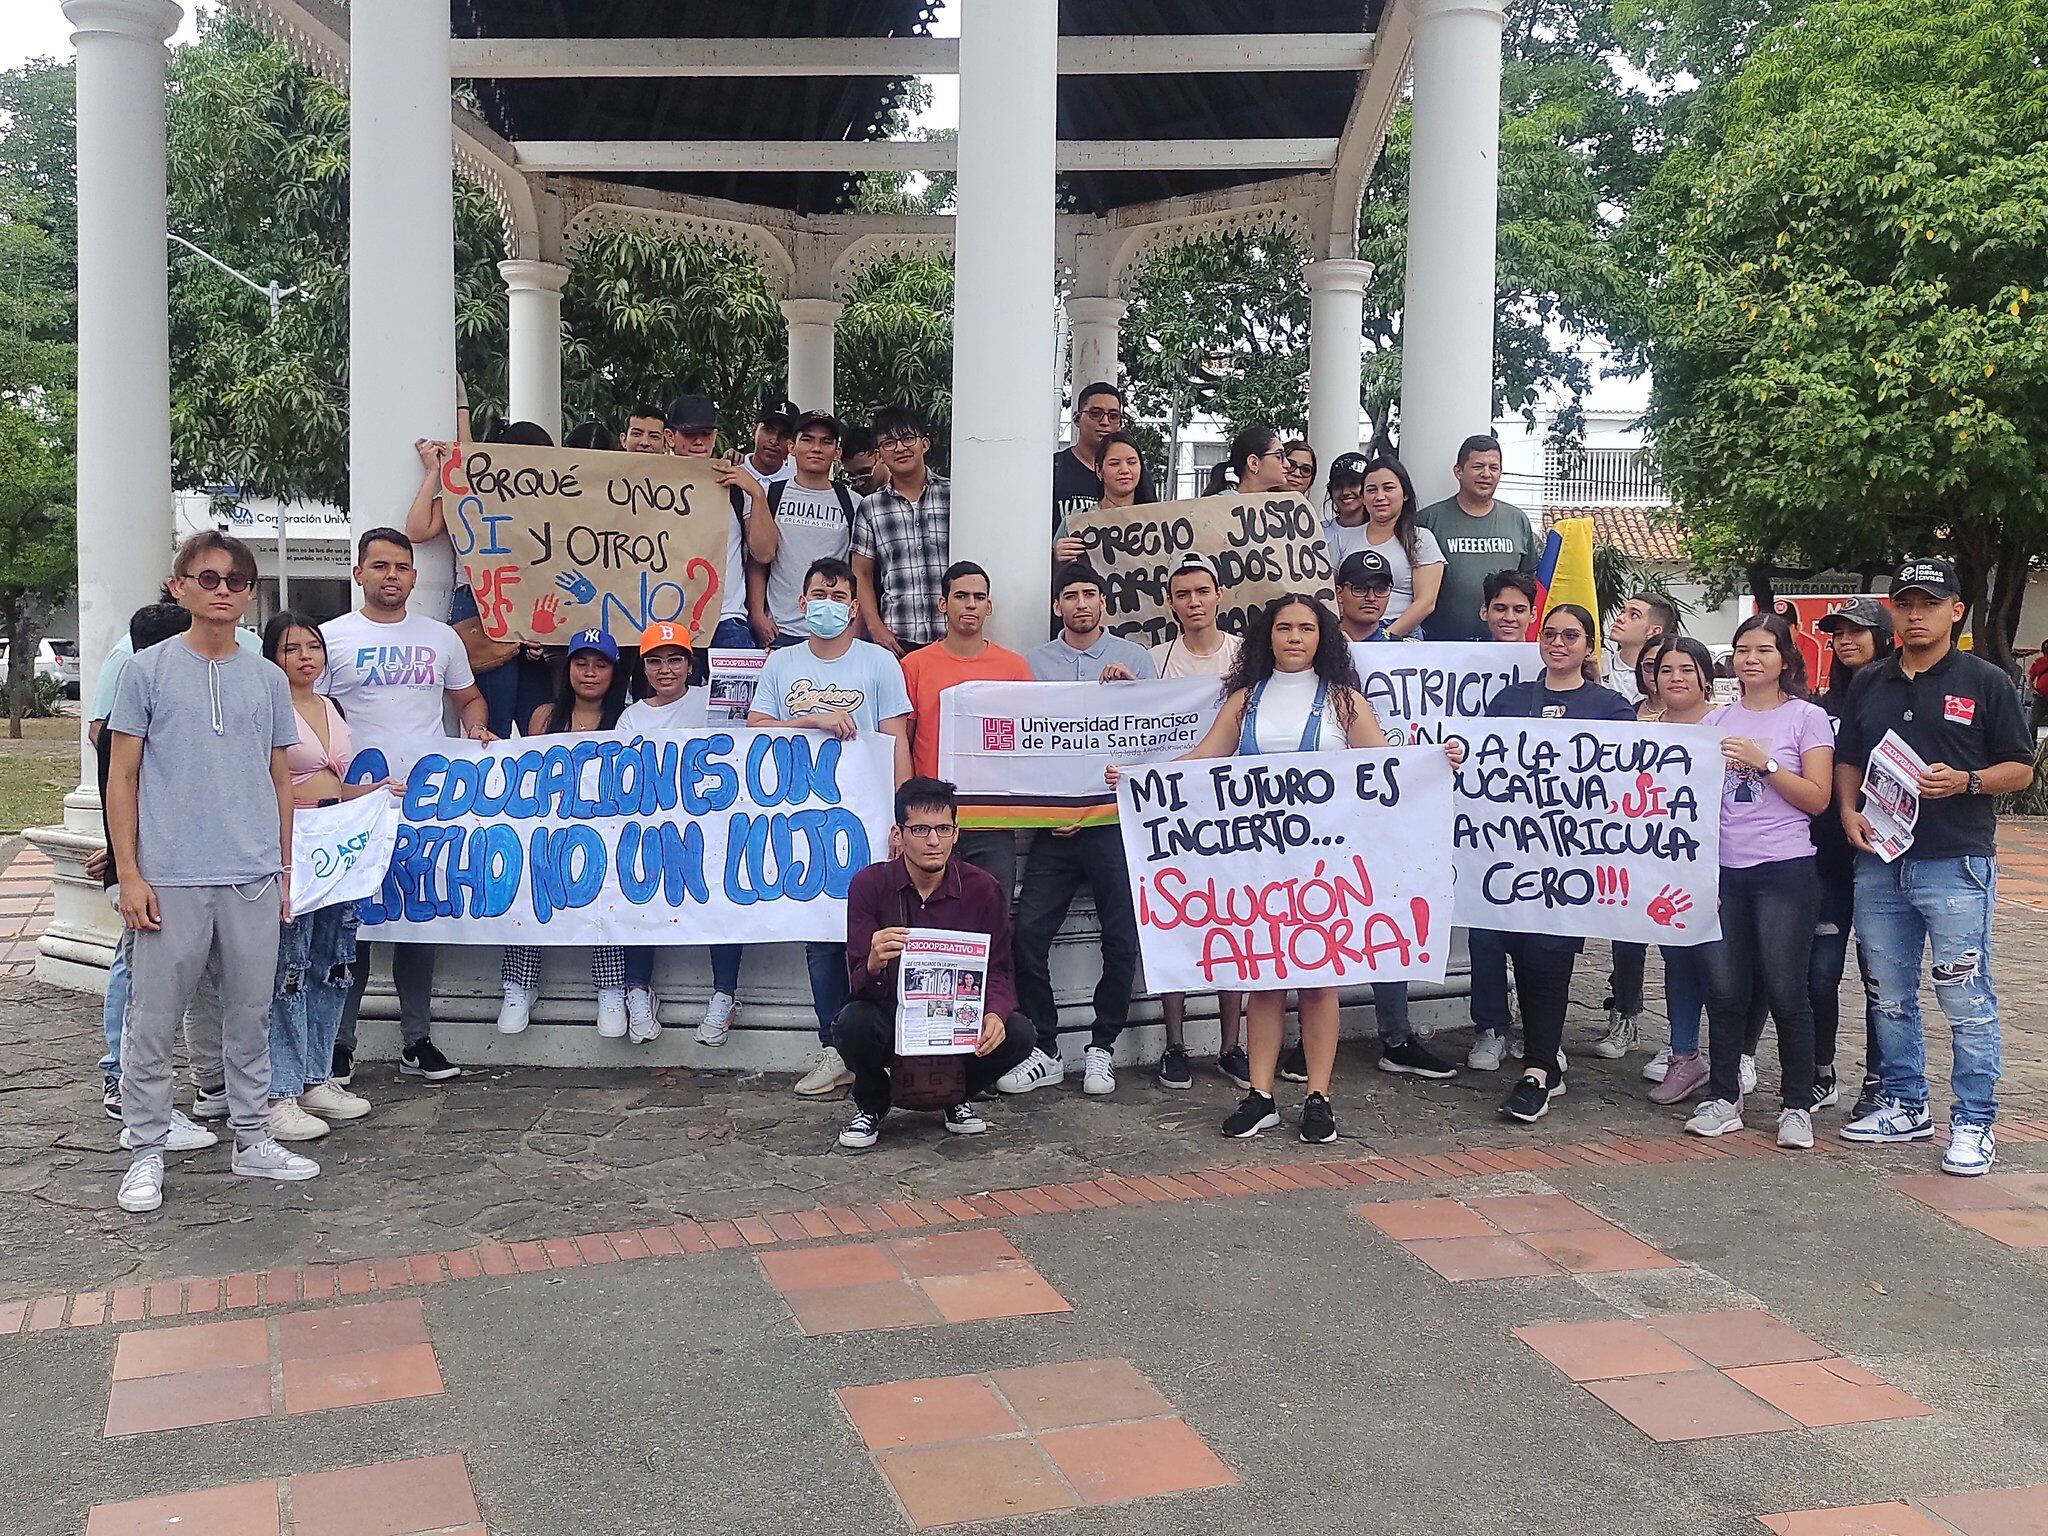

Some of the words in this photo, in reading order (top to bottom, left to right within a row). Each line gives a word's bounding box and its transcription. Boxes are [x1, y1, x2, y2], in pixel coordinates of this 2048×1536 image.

[607, 478, 694, 515] UNOS
[778, 502, 845, 523] EQUALITY
[451, 496, 513, 555] SI
[566, 525, 669, 573] OTROS
[1227, 500, 1316, 546] JUSTO
[1286, 540, 1333, 582] LOS
[1447, 538, 1514, 553] WEEEEKEND
[660, 625, 675, 641] B
[356, 646, 436, 668] FIND
[713, 659, 764, 667] PSICOOPERATIVO
[1021, 716, 1119, 733] Universidad
[1124, 711, 1199, 731] Francisco
[1022, 734, 1044, 749] de
[1051, 734, 1100, 750] Paula
[1107, 728, 1198, 748] Santander
[1476, 734, 1509, 765] A
[1517, 731, 1561, 770] LA
[1568, 733, 1693, 775] DEUDA
[402, 734, 679, 822] EDUCACIÓN
[681, 733, 740, 816] ES
[746, 733, 842, 807] UN
[1129, 769, 1188, 813] MI
[1210, 765, 1334, 811] FUTURO
[1356, 757, 1401, 807] ES
[1623, 772, 1669, 818] SI
[1667, 786, 1698, 822] A
[1143, 810, 1345, 862] INCIERTO...
[1482, 810, 1700, 861] MATRICULA
[530, 824, 608, 924] NO
[616, 820, 709, 908] UN
[724, 807, 871, 906] LUJO
[907, 941, 974, 954] PSICOOPERATIVO
[1196, 896, 1431, 982] AHORA!
